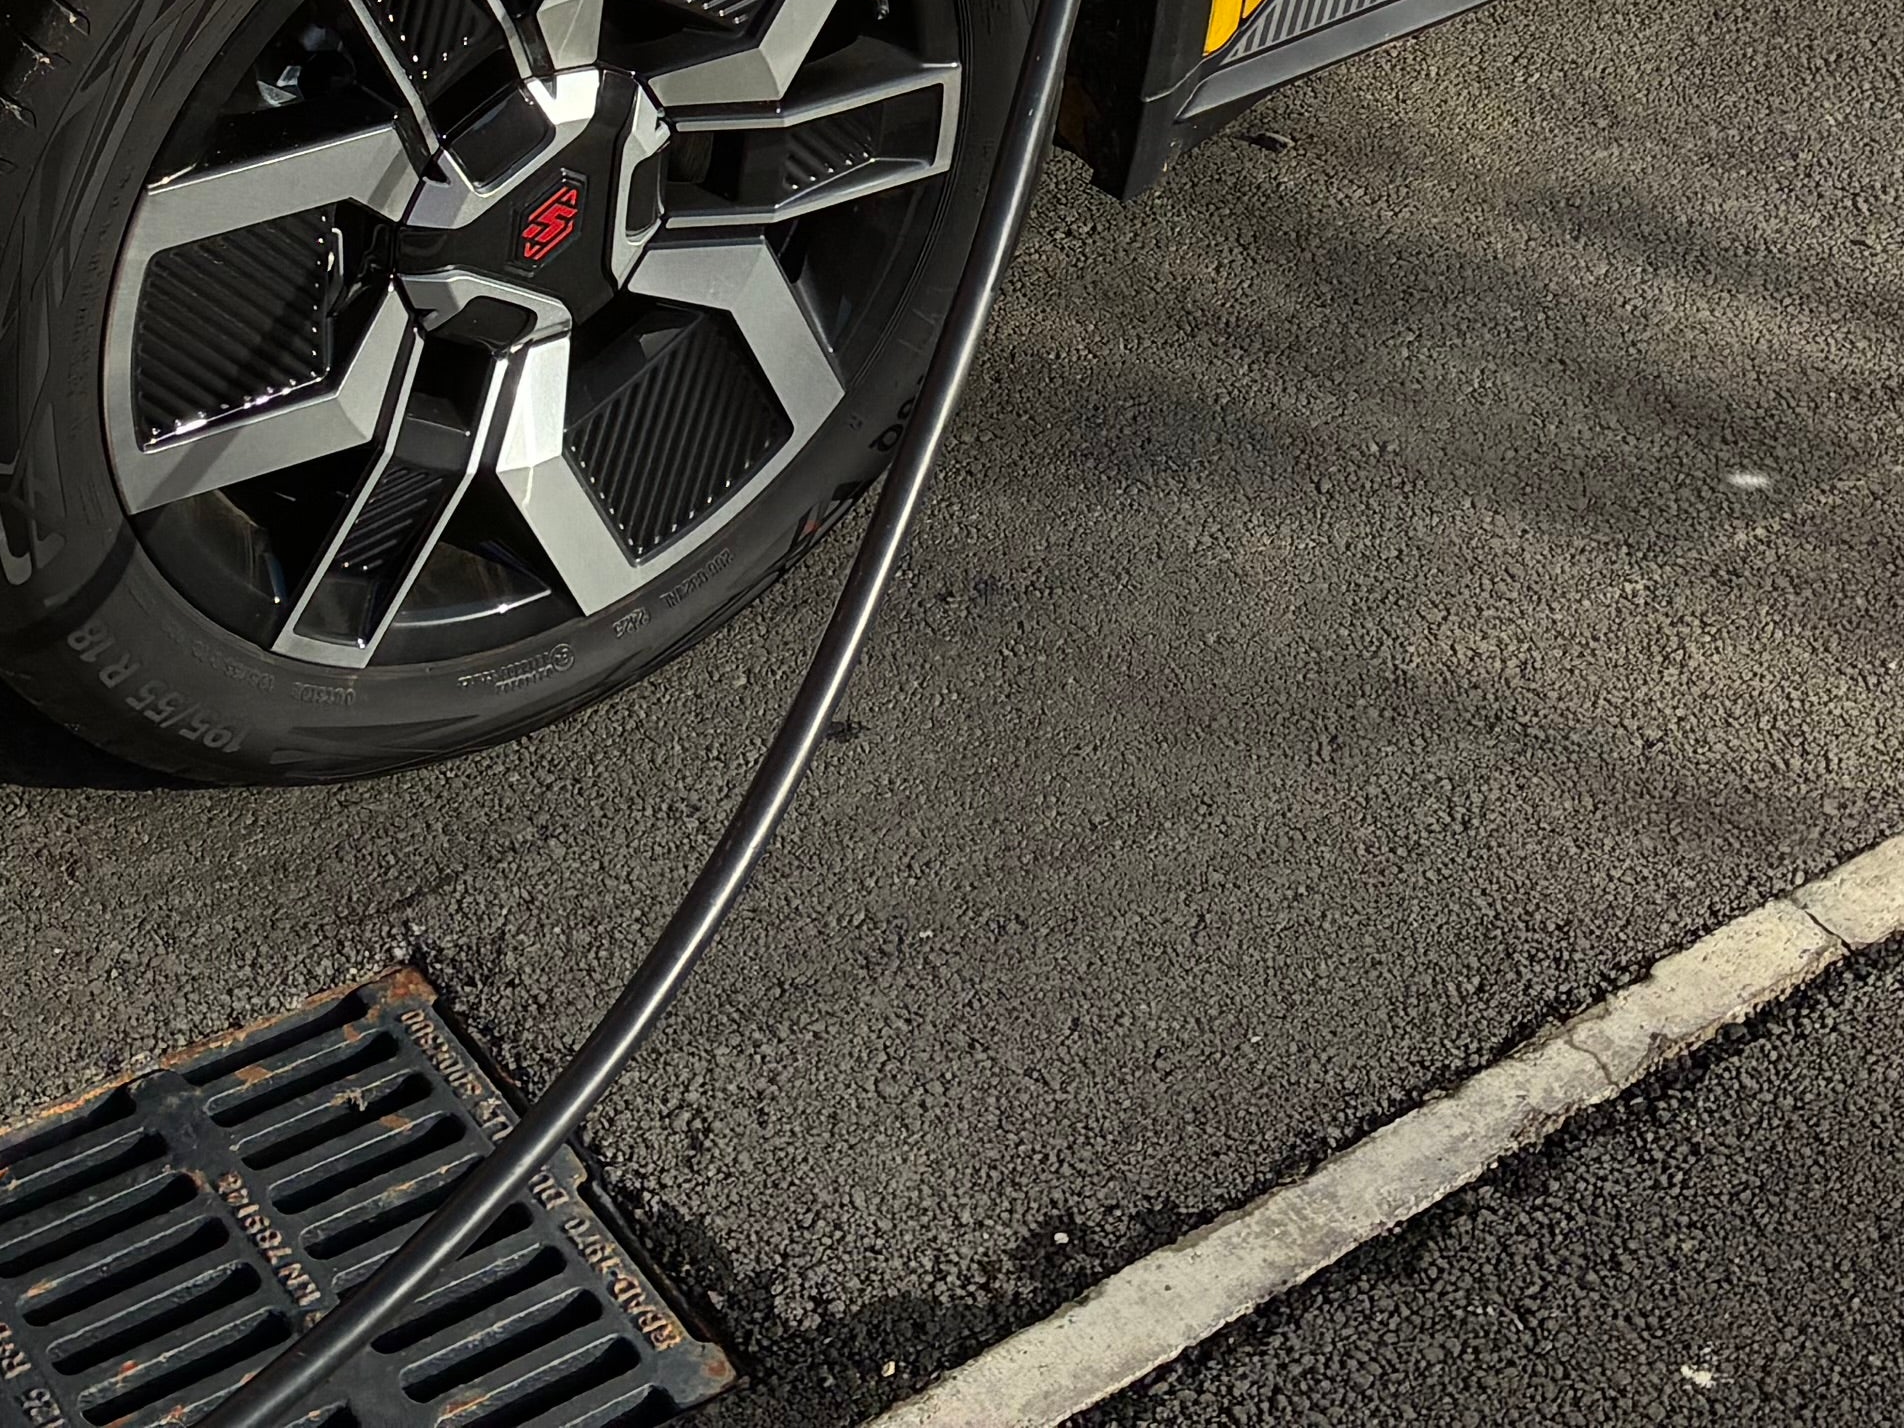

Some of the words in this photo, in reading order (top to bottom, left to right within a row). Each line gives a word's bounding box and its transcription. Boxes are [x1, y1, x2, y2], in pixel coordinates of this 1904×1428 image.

[67, 619, 115, 663] 18
[99, 652, 141, 689] R
[125, 679, 247, 753] 195/55
